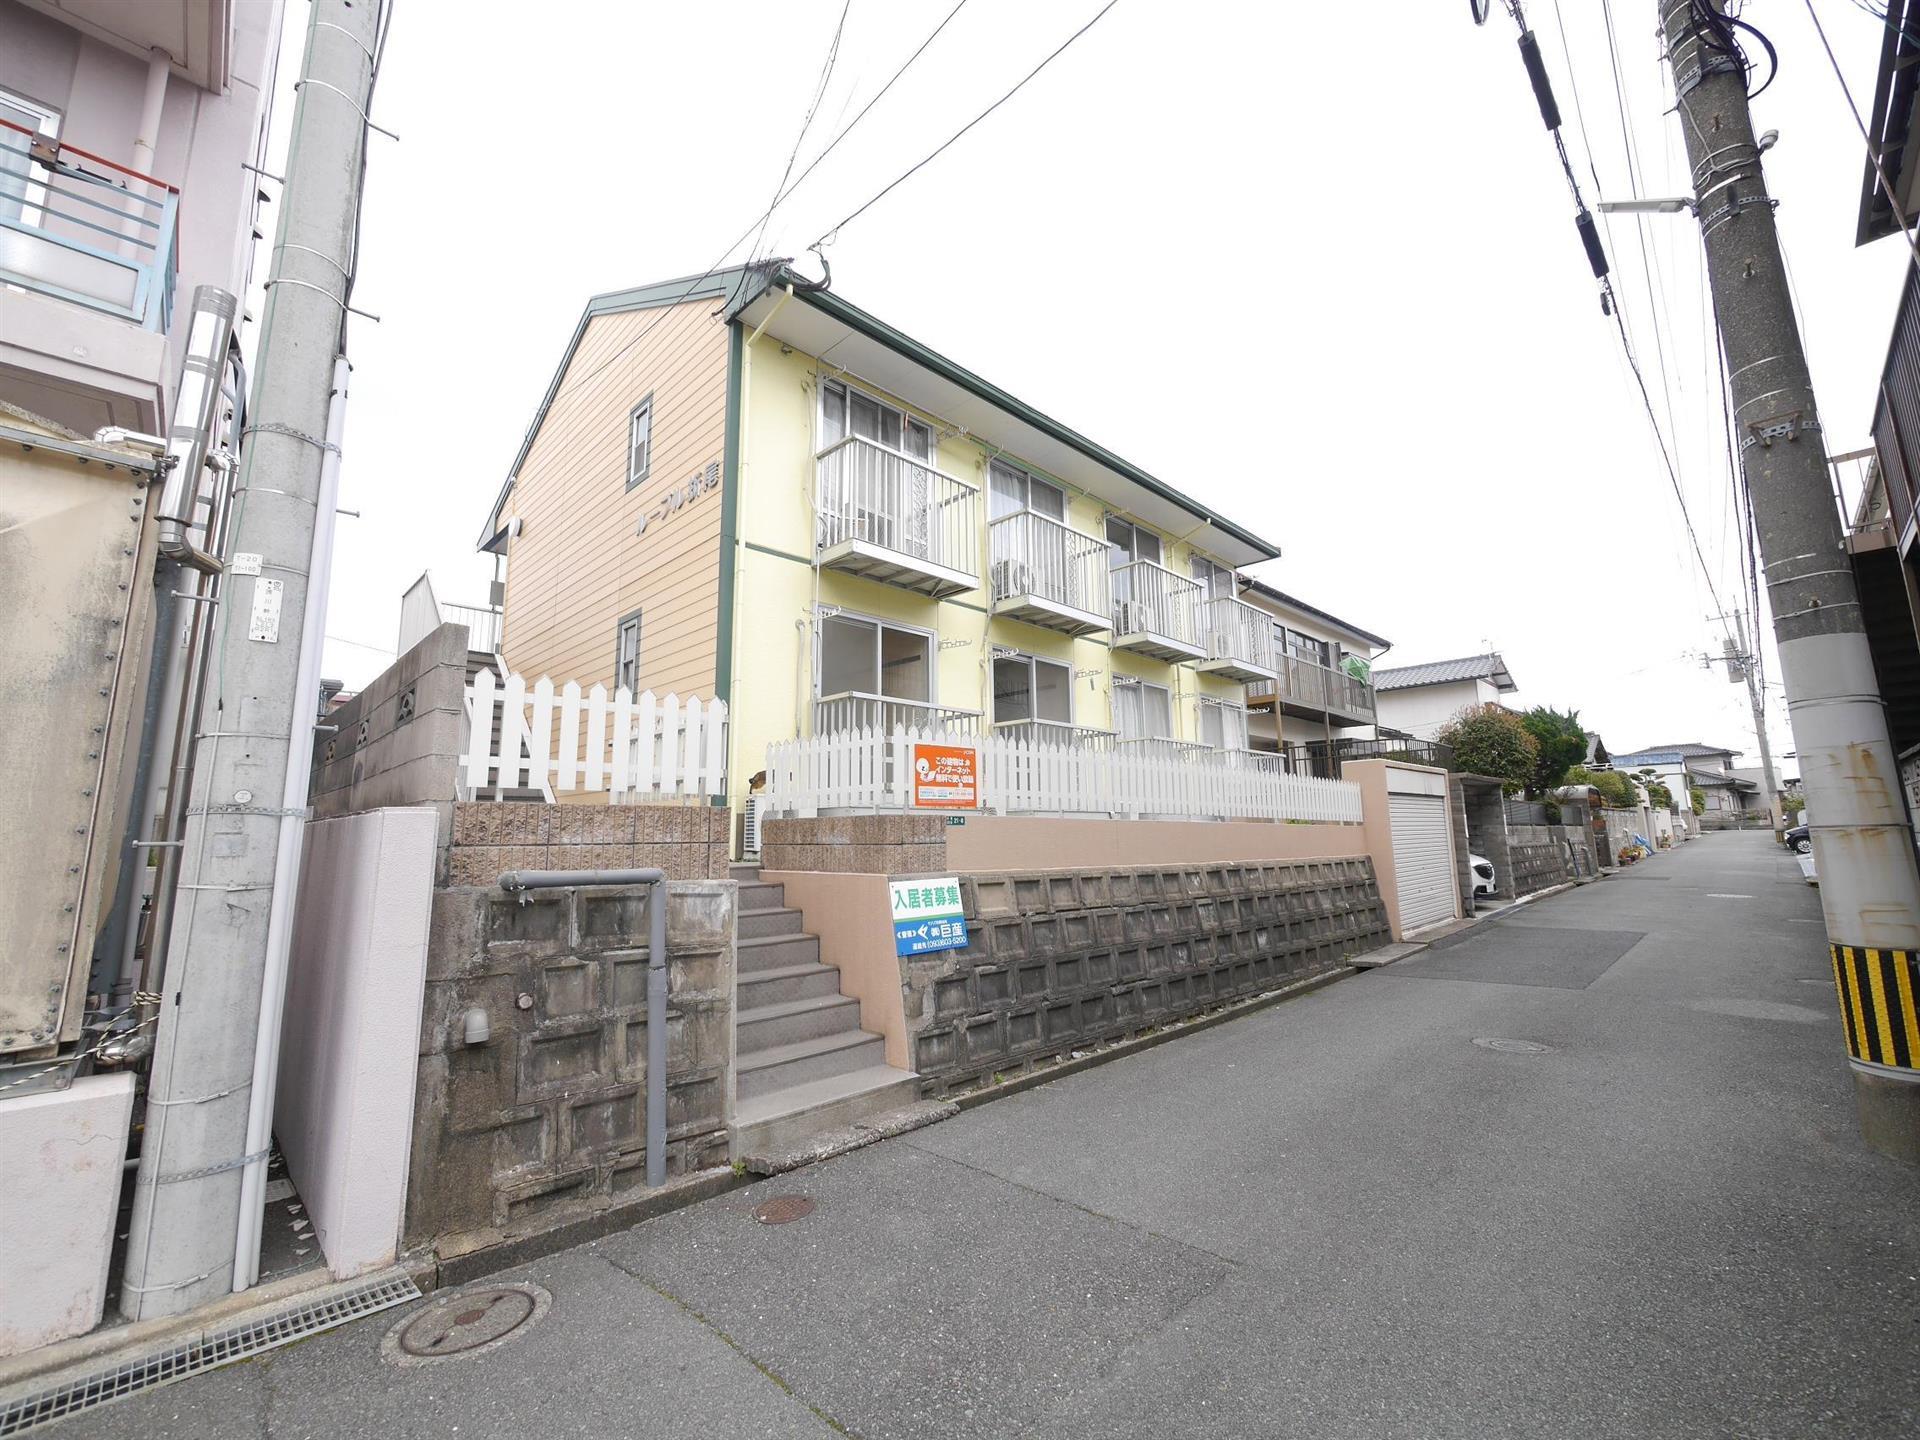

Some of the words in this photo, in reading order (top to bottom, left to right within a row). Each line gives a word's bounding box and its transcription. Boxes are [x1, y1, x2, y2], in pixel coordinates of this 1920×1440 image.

[936, 766, 971, 774] インターネット
[894, 885, 960, 910] 入居者募集
